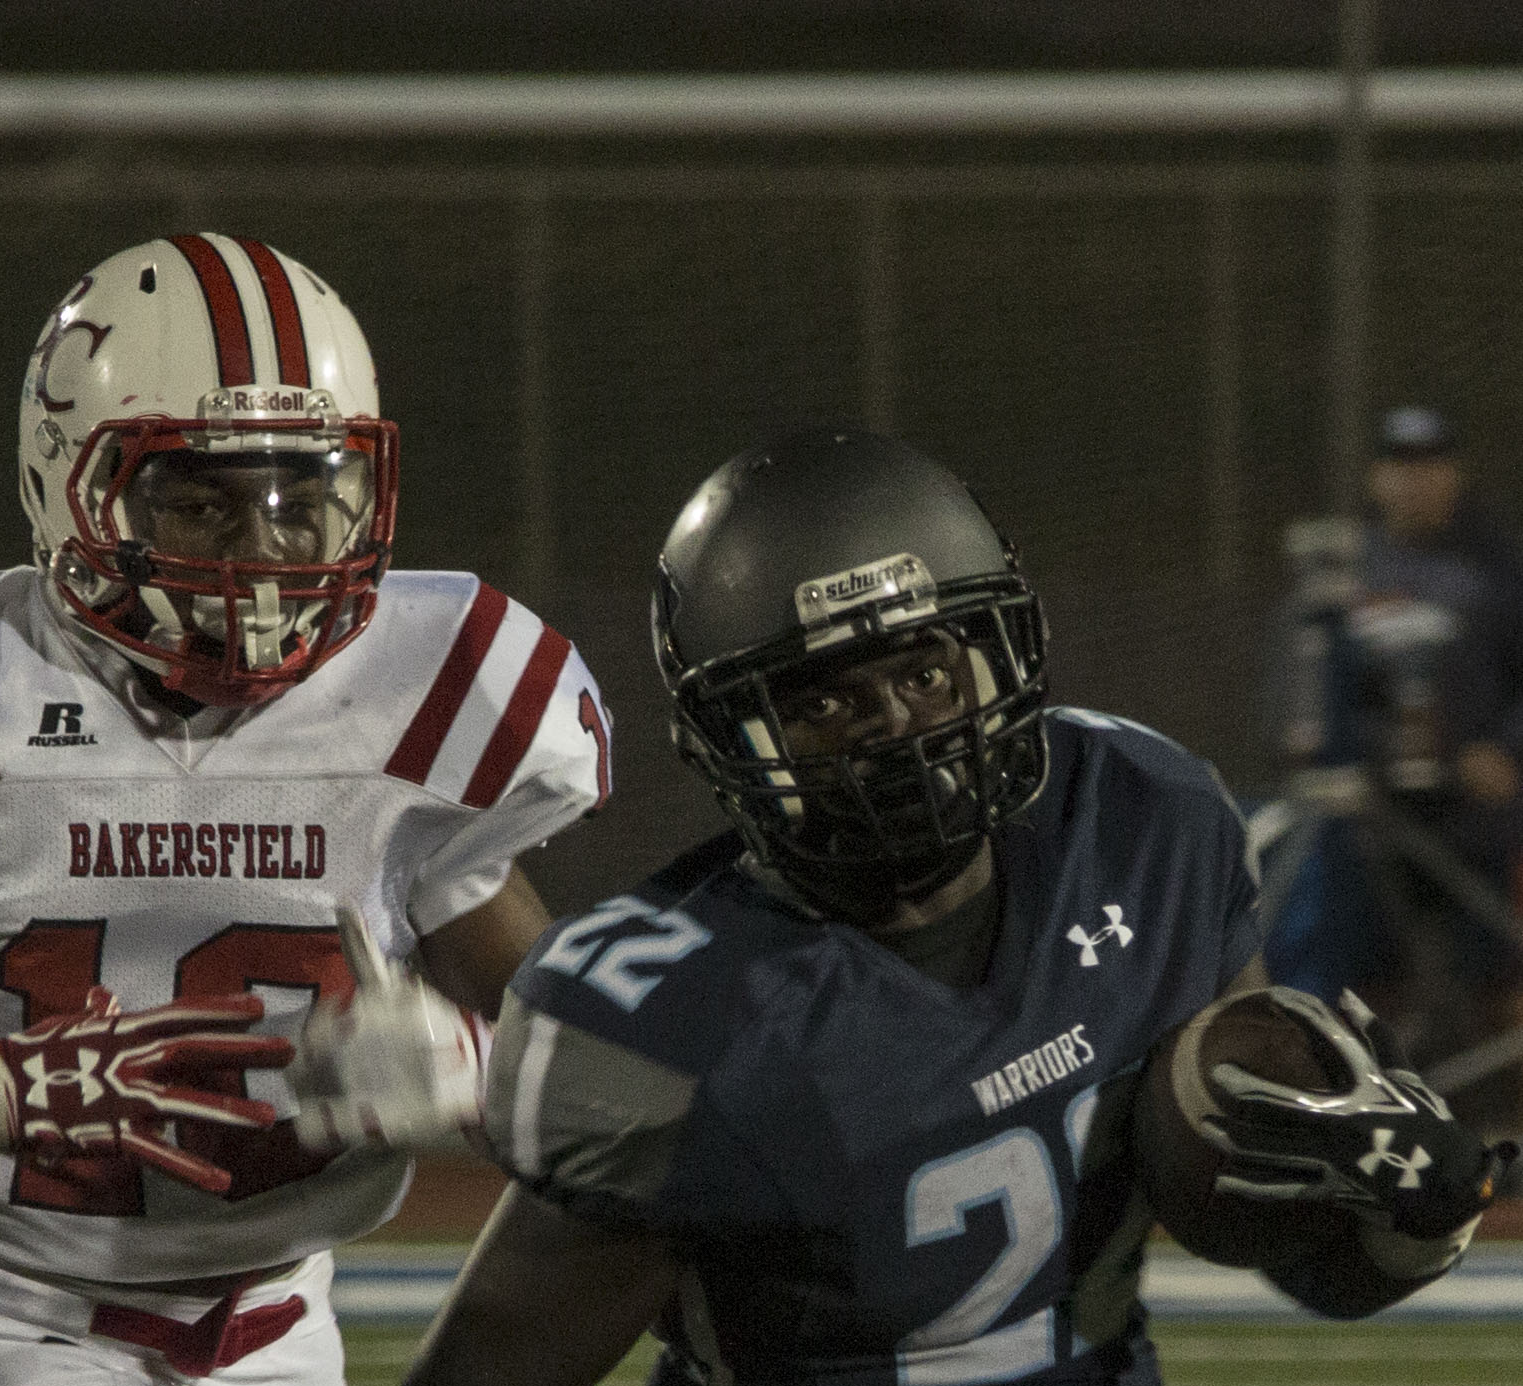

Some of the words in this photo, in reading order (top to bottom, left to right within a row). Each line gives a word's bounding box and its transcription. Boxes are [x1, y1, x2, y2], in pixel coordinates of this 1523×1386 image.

[27, 734, 99, 747] RUSSELL
[69, 821, 326, 879] BAKERSFIELD
[535, 895, 715, 1013] 22
[971, 1023, 1096, 1117] WARRIORS
